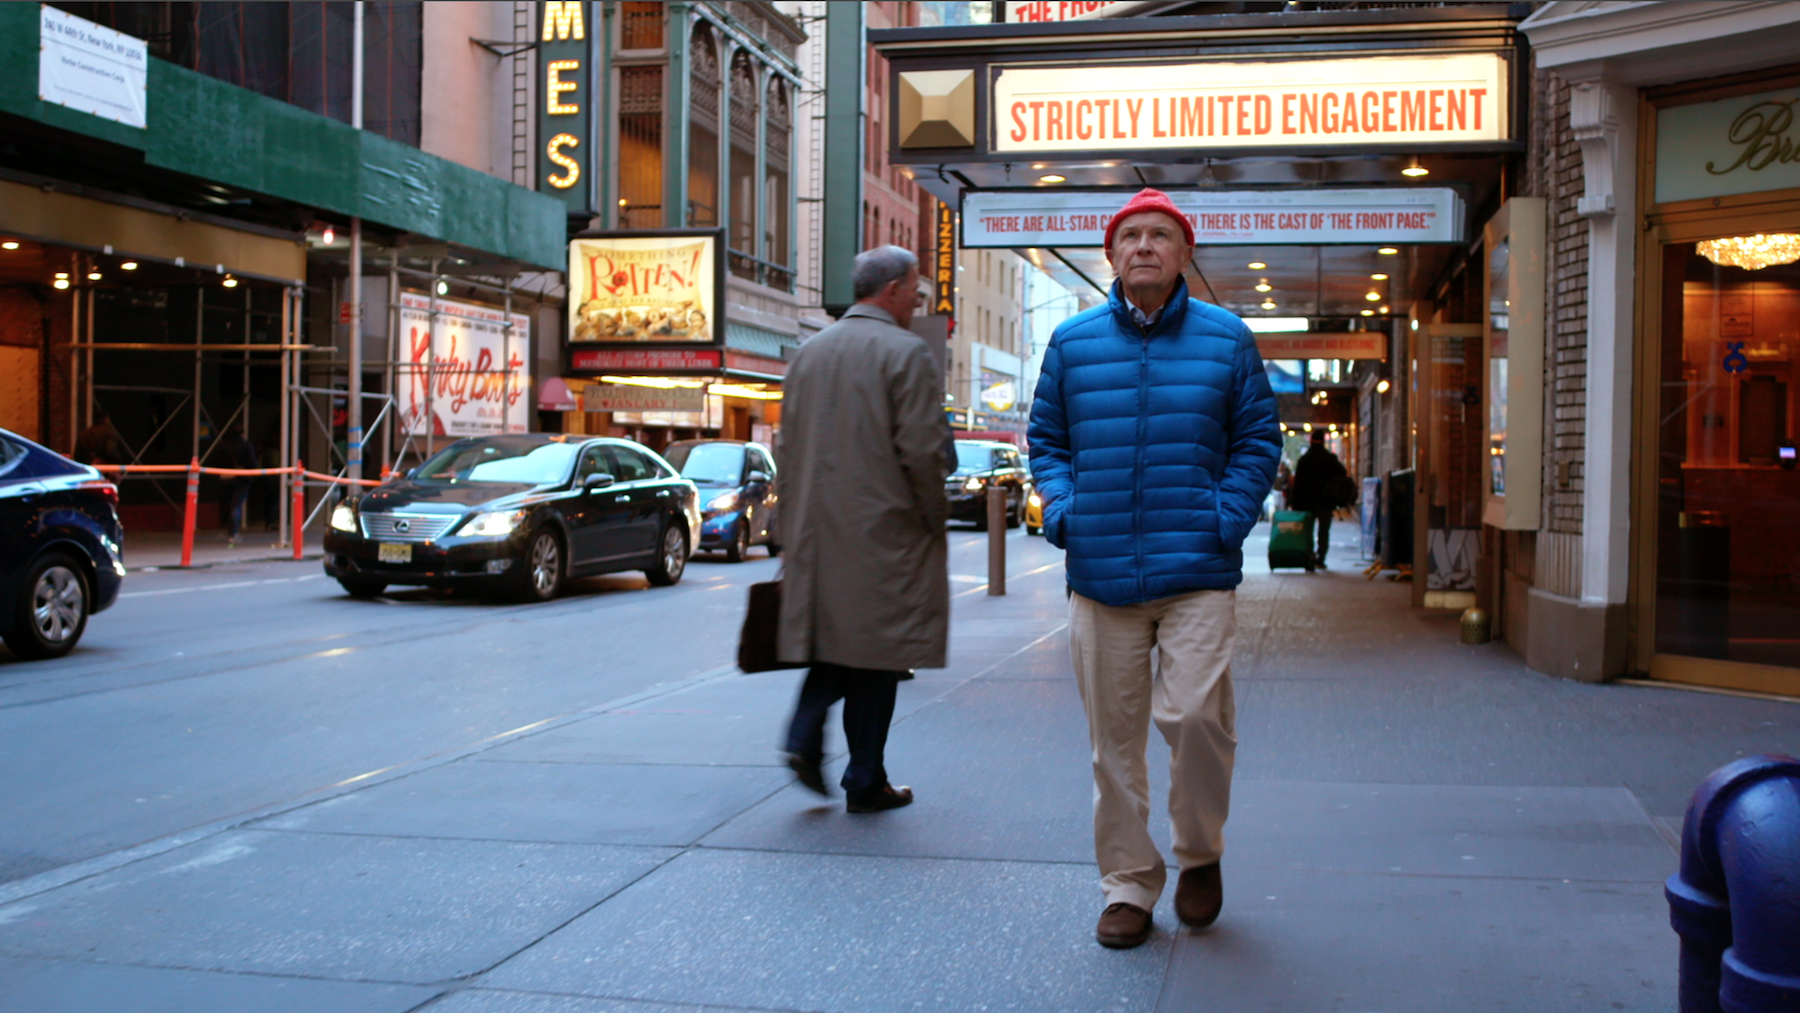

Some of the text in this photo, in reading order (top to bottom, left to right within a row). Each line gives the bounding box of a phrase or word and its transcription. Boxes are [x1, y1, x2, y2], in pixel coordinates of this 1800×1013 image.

[1015, 1, 1054, 22] THE
[1010, 88, 1488, 142] STRICTLY LIMITED ENGAGEMENT
[979, 216, 1021, 232] "THERE
[1022, 215, 1044, 232] ARE
[1046, 214, 1098, 231] ALL-STAR
[1200, 213, 1237, 230] THERE
[1240, 213, 1252, 230] IS
[1253, 213, 1276, 230] THE
[1278, 213, 1308, 230] CAST
[1310, 213, 1325, 229] OF
[1356, 213, 1395, 229] FRONT
[596, 248, 686, 260] SOMETHING
[597, 351, 613, 359] ALL
[647, 351, 682, 359] PROMISE
[684, 351, 696, 359] TO
[579, 359, 622, 367] MEMORIZE
[625, 359, 647, 367] MOST
[649, 359, 659, 367] OF
[660, 359, 685, 367] THEIR
[610, 399, 665, 409] JANUARY
